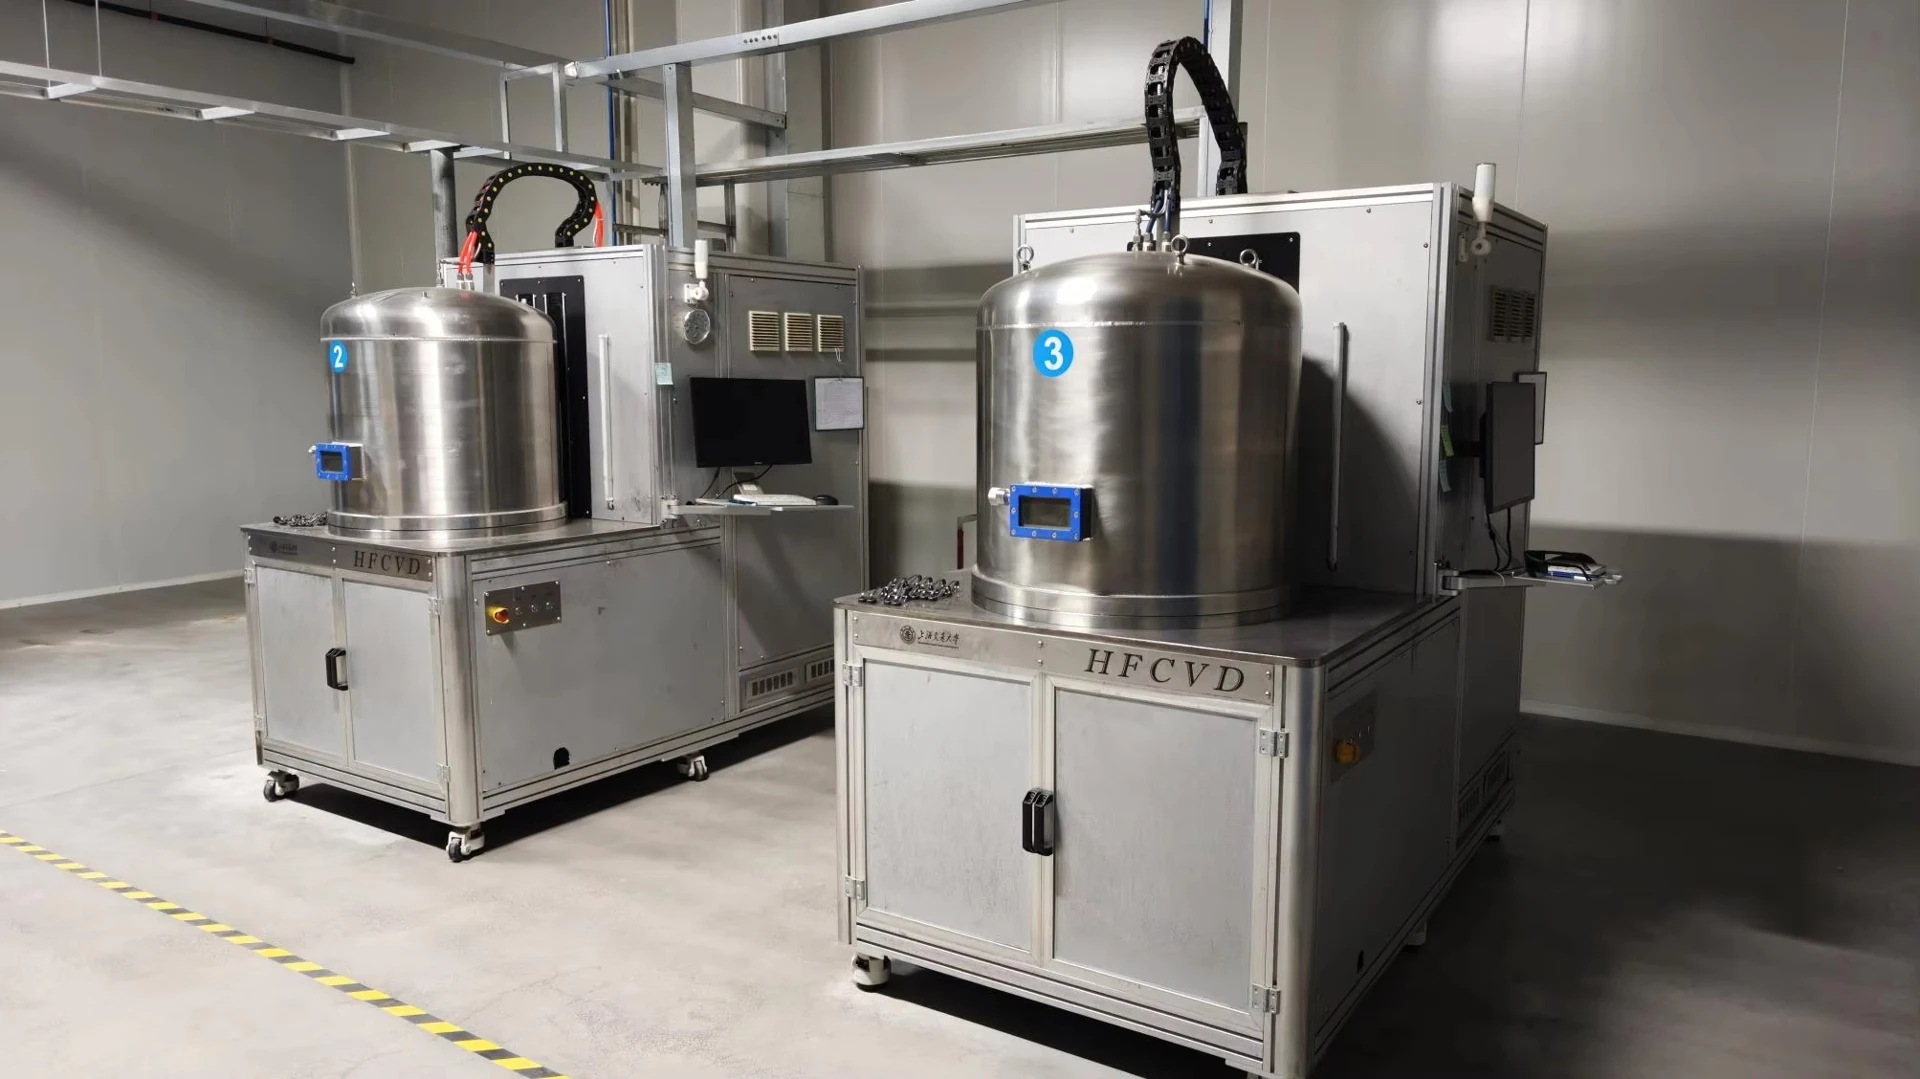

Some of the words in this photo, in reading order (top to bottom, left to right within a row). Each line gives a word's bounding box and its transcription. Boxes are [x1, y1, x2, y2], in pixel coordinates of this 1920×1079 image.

[333, 345, 344, 368] 2
[1044, 336, 1064, 371] 3
[353, 550, 421, 576] HFCVD
[1084, 648, 1245, 692] HFCVD
